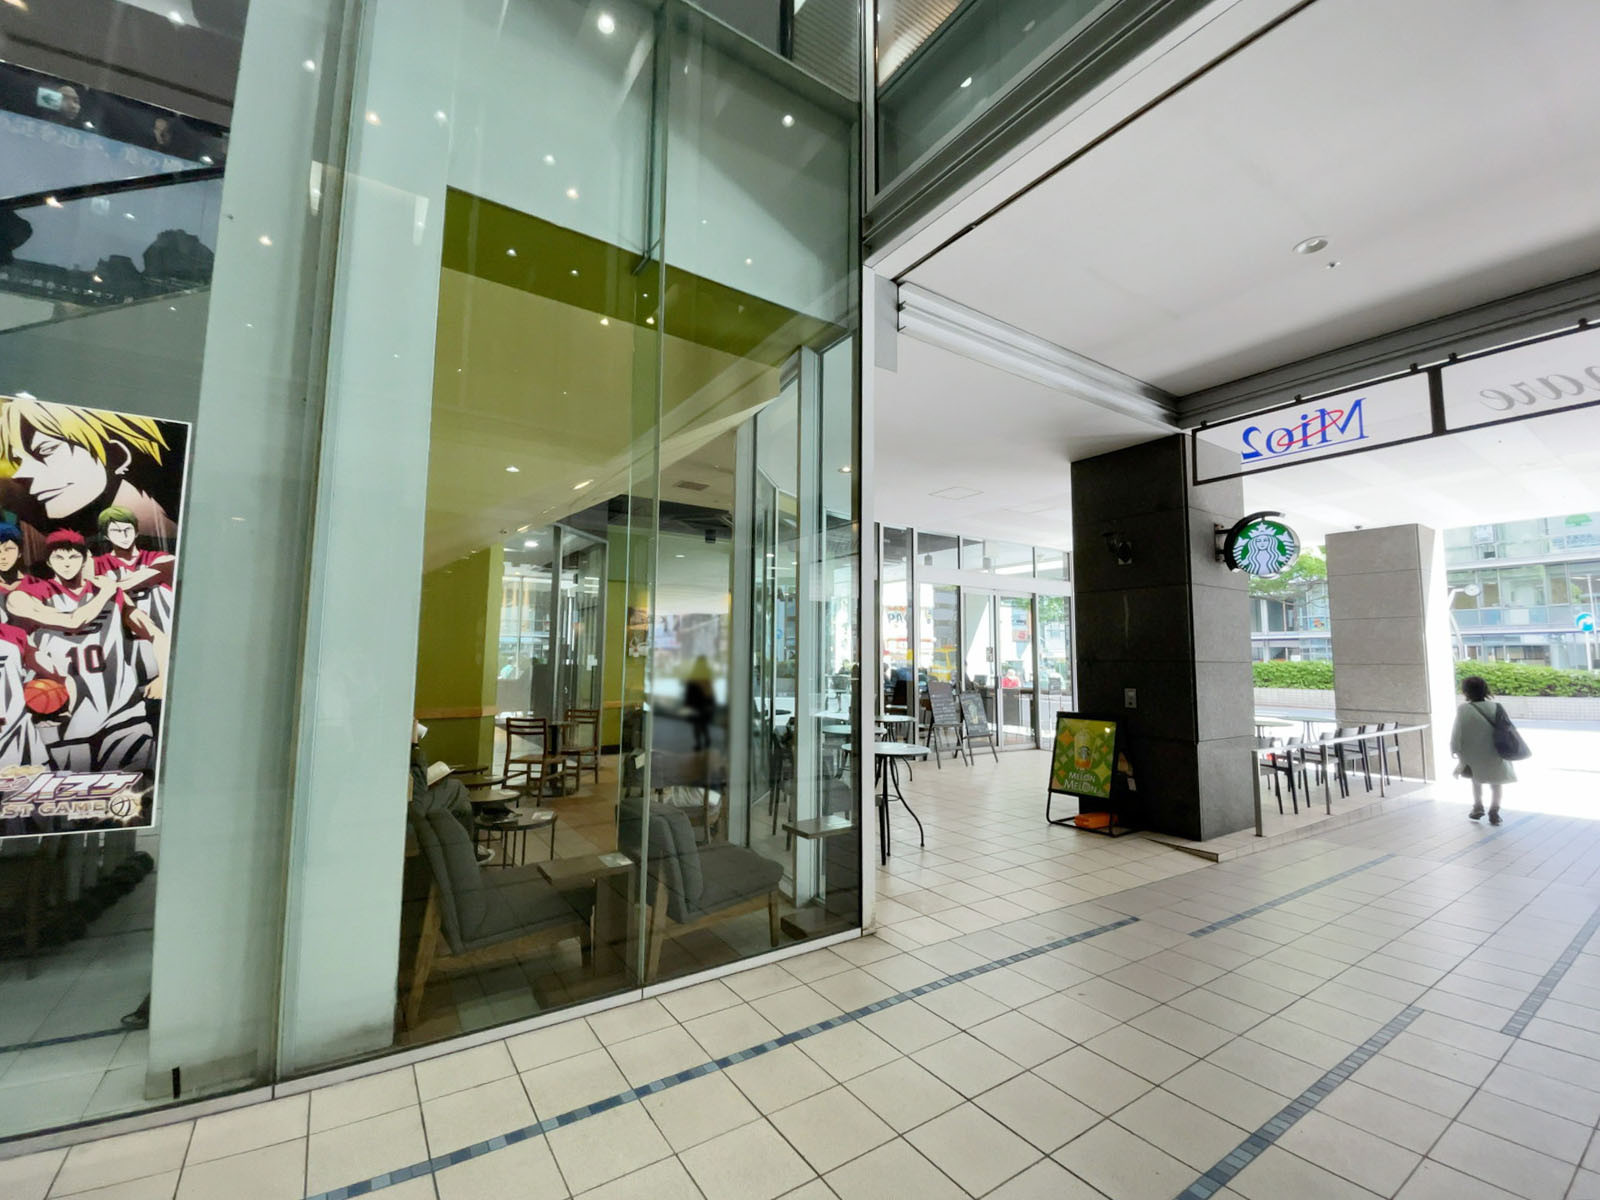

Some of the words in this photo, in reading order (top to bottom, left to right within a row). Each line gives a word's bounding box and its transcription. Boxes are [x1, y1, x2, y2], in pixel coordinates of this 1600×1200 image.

[66, 644, 106, 675] 10
[0, 804, 33, 817] ST
[40, 802, 106, 815] GAME
